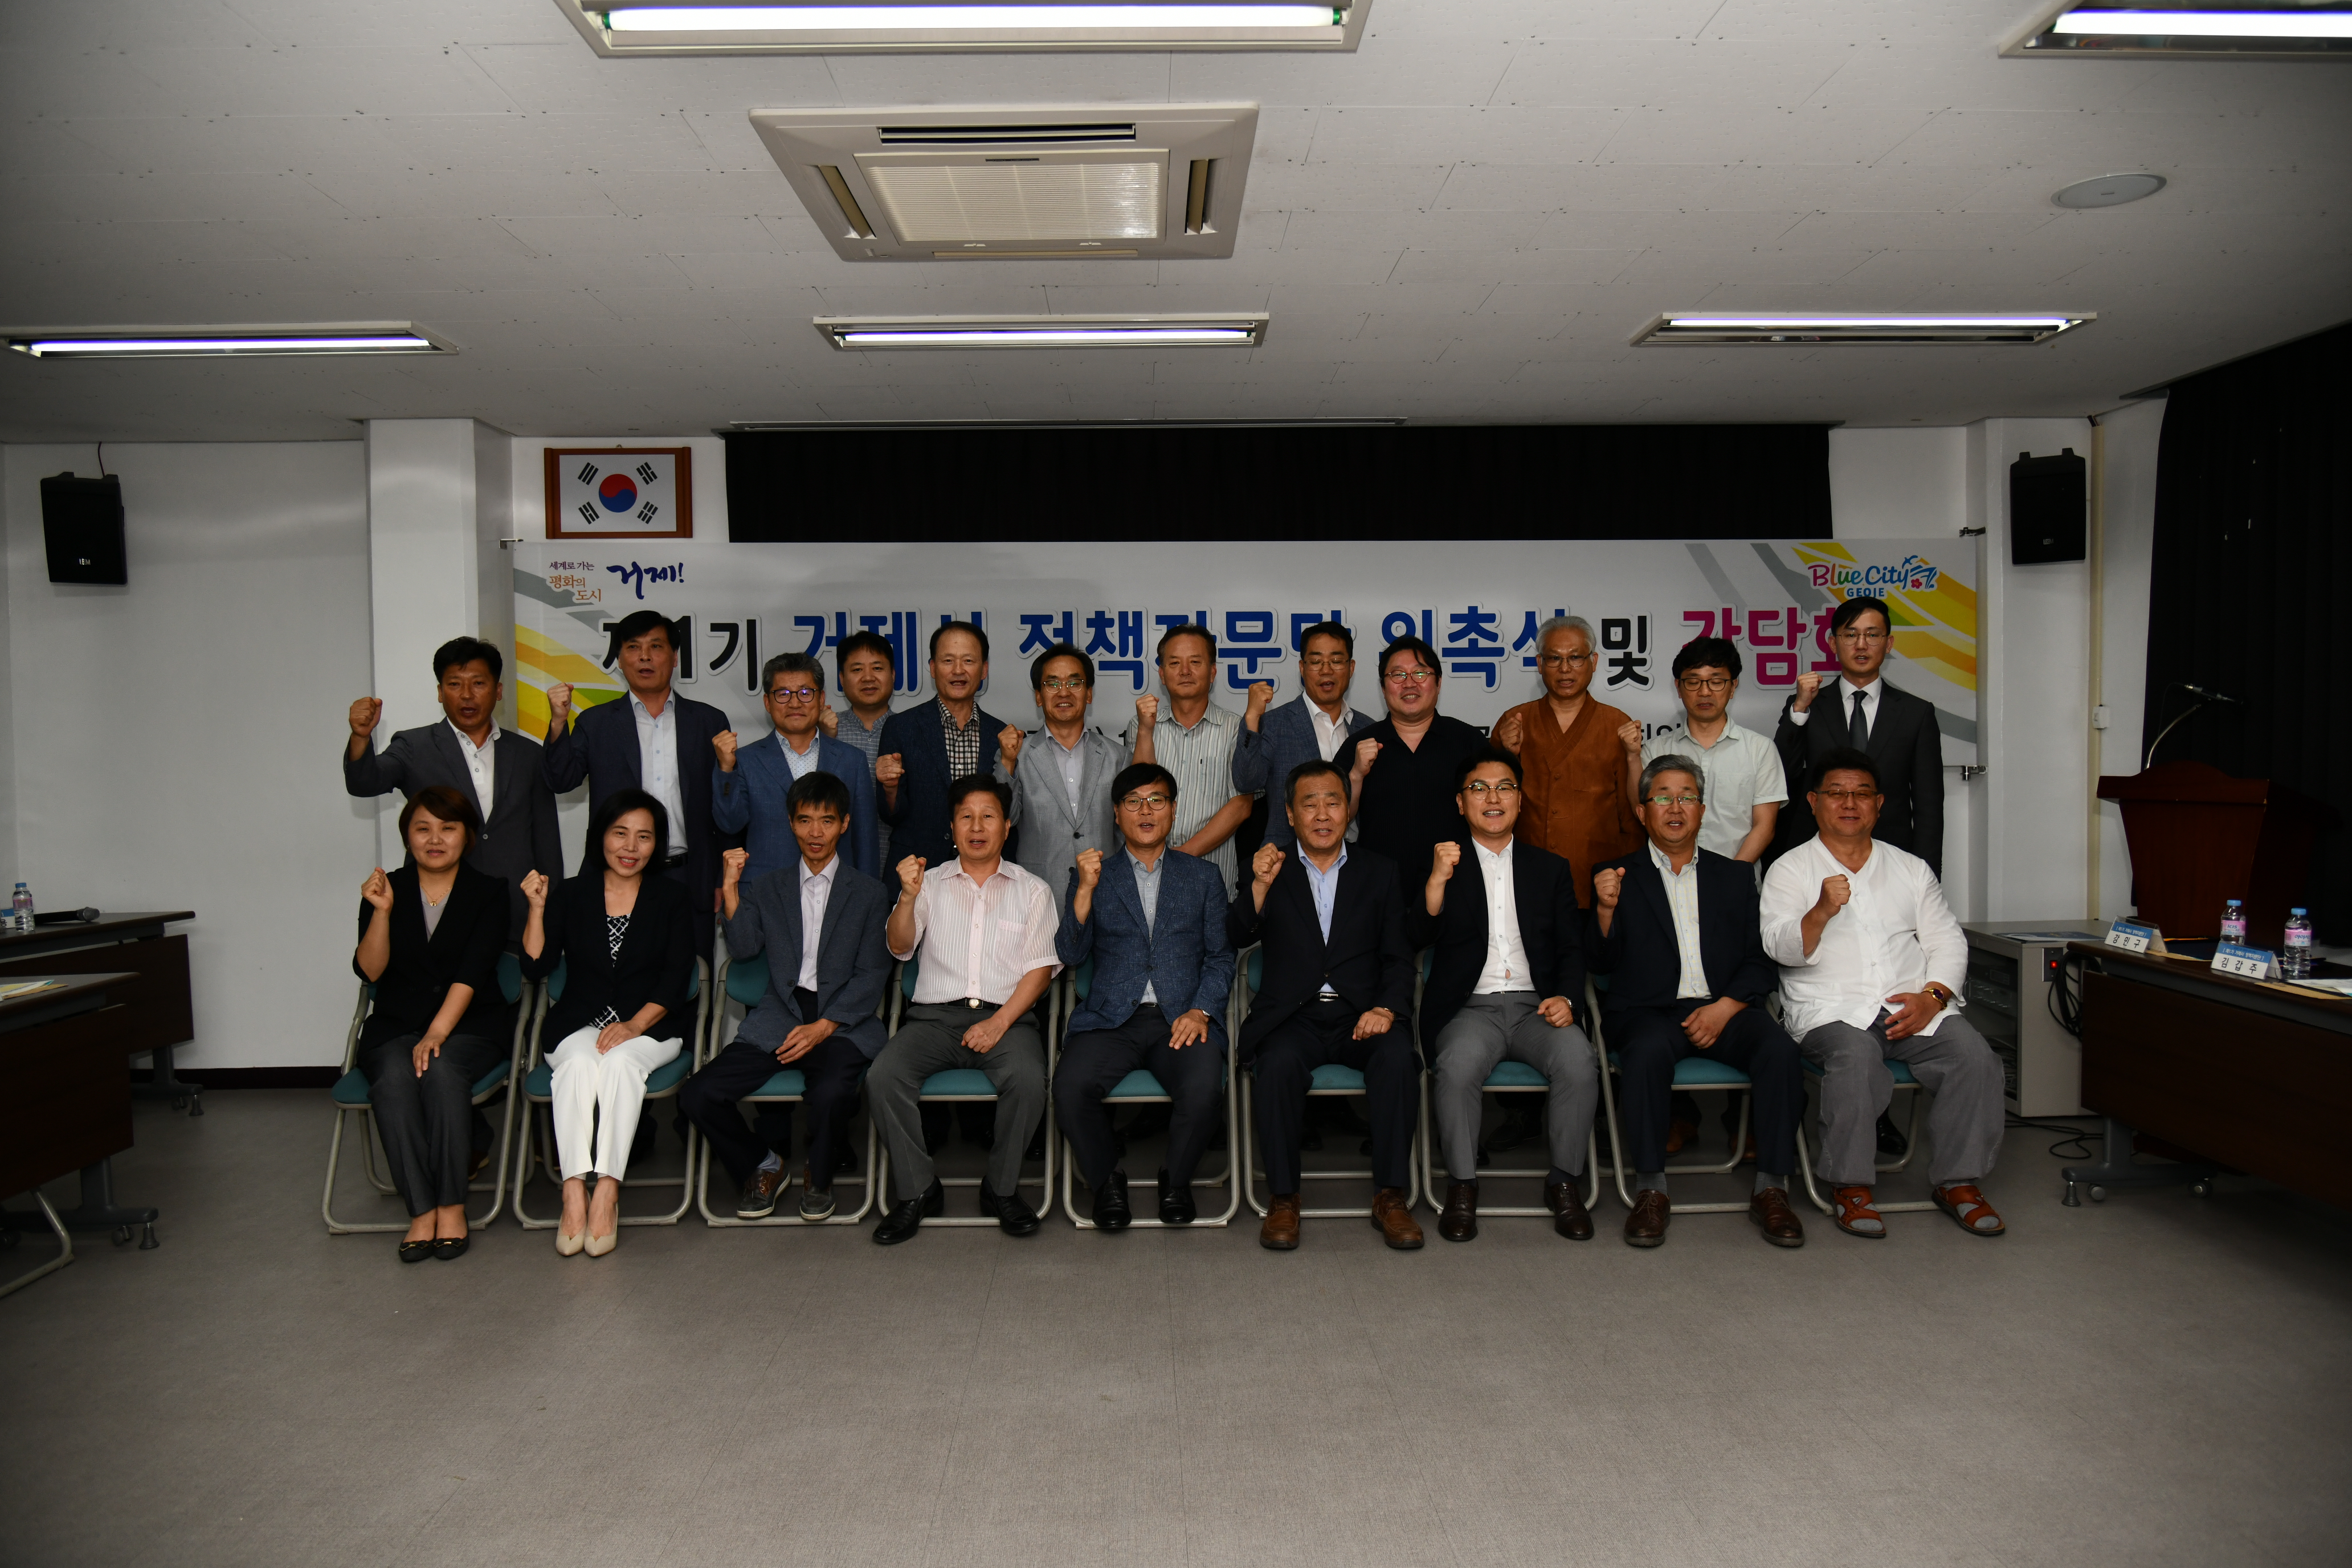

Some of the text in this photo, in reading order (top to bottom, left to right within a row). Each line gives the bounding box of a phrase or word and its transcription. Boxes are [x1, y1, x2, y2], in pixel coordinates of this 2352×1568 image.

[549, 561, 595, 571] 세계로 가는
[549, 574, 586, 589] 평화의
[606, 561, 684, 599] 거제!
[1808, 564, 1909, 590] Blue City
[575, 589, 601, 602] 도시
[1847, 587, 1885, 598] GEOJE
[1602, 615, 1649, 686] 및
